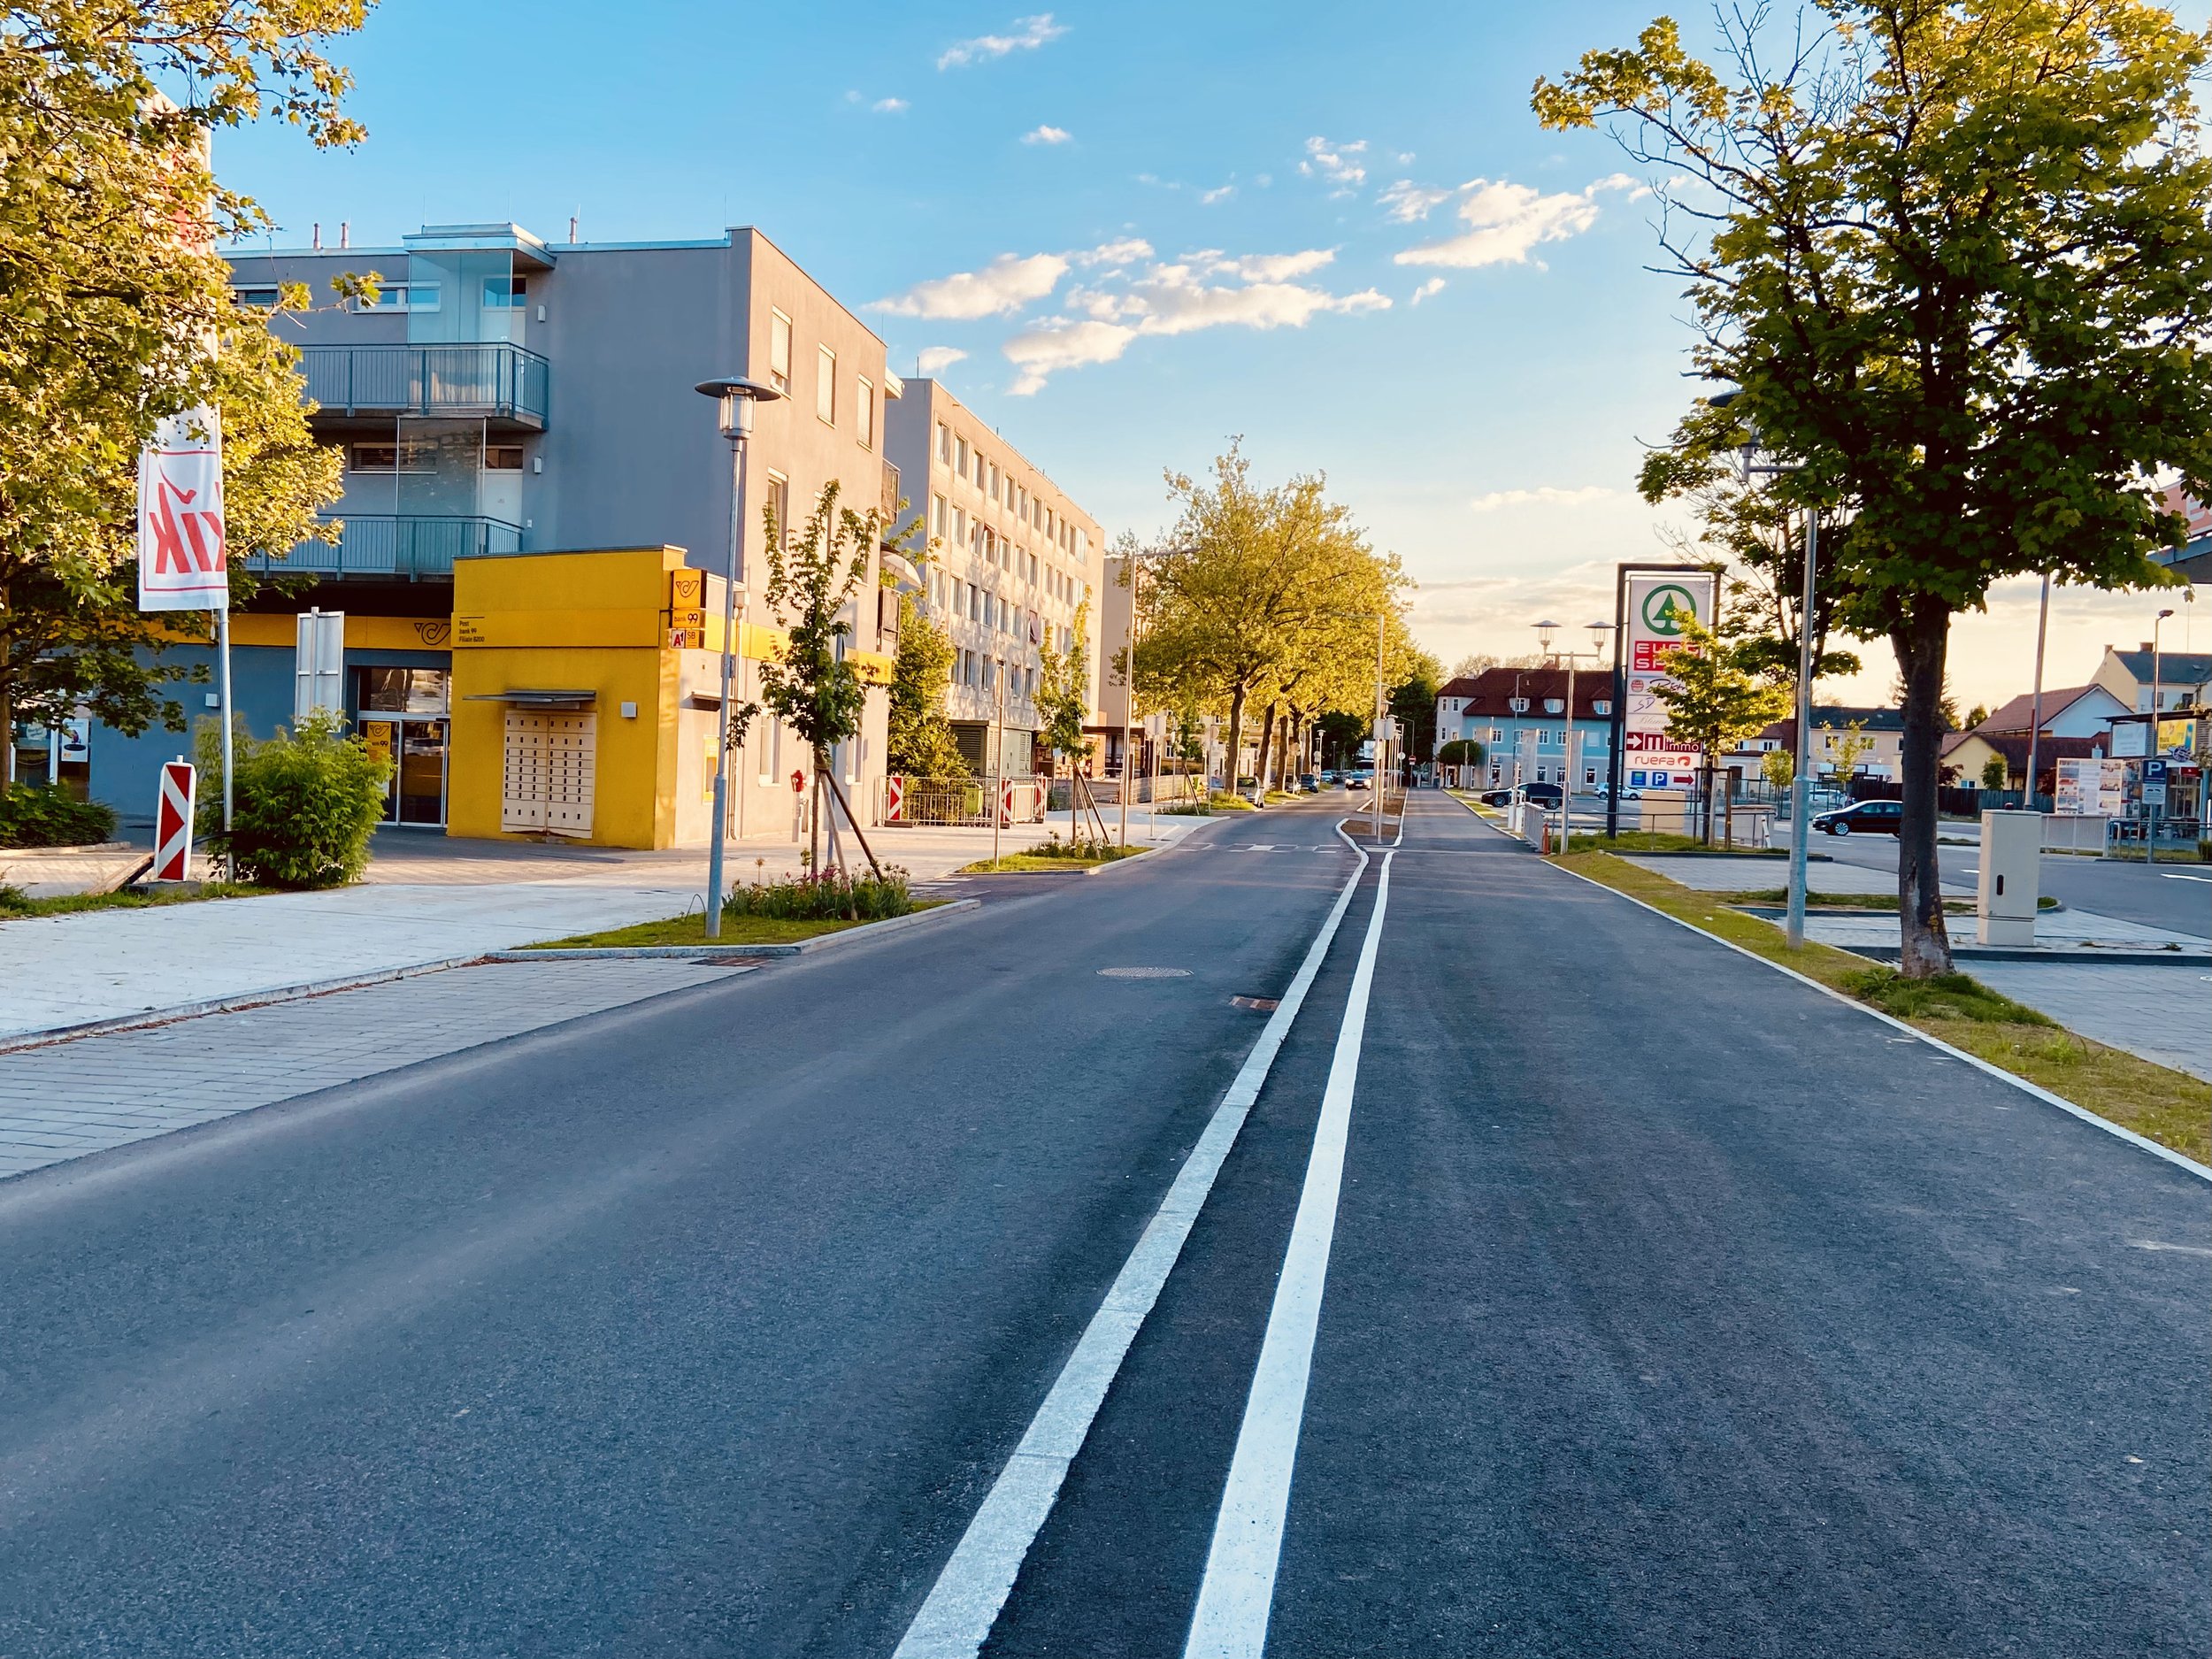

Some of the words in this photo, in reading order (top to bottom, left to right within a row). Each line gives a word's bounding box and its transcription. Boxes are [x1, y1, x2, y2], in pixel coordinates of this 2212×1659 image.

[687, 613, 698, 624] 99
[2147, 761, 2162, 776] P
[1655, 772, 1664, 785] P
